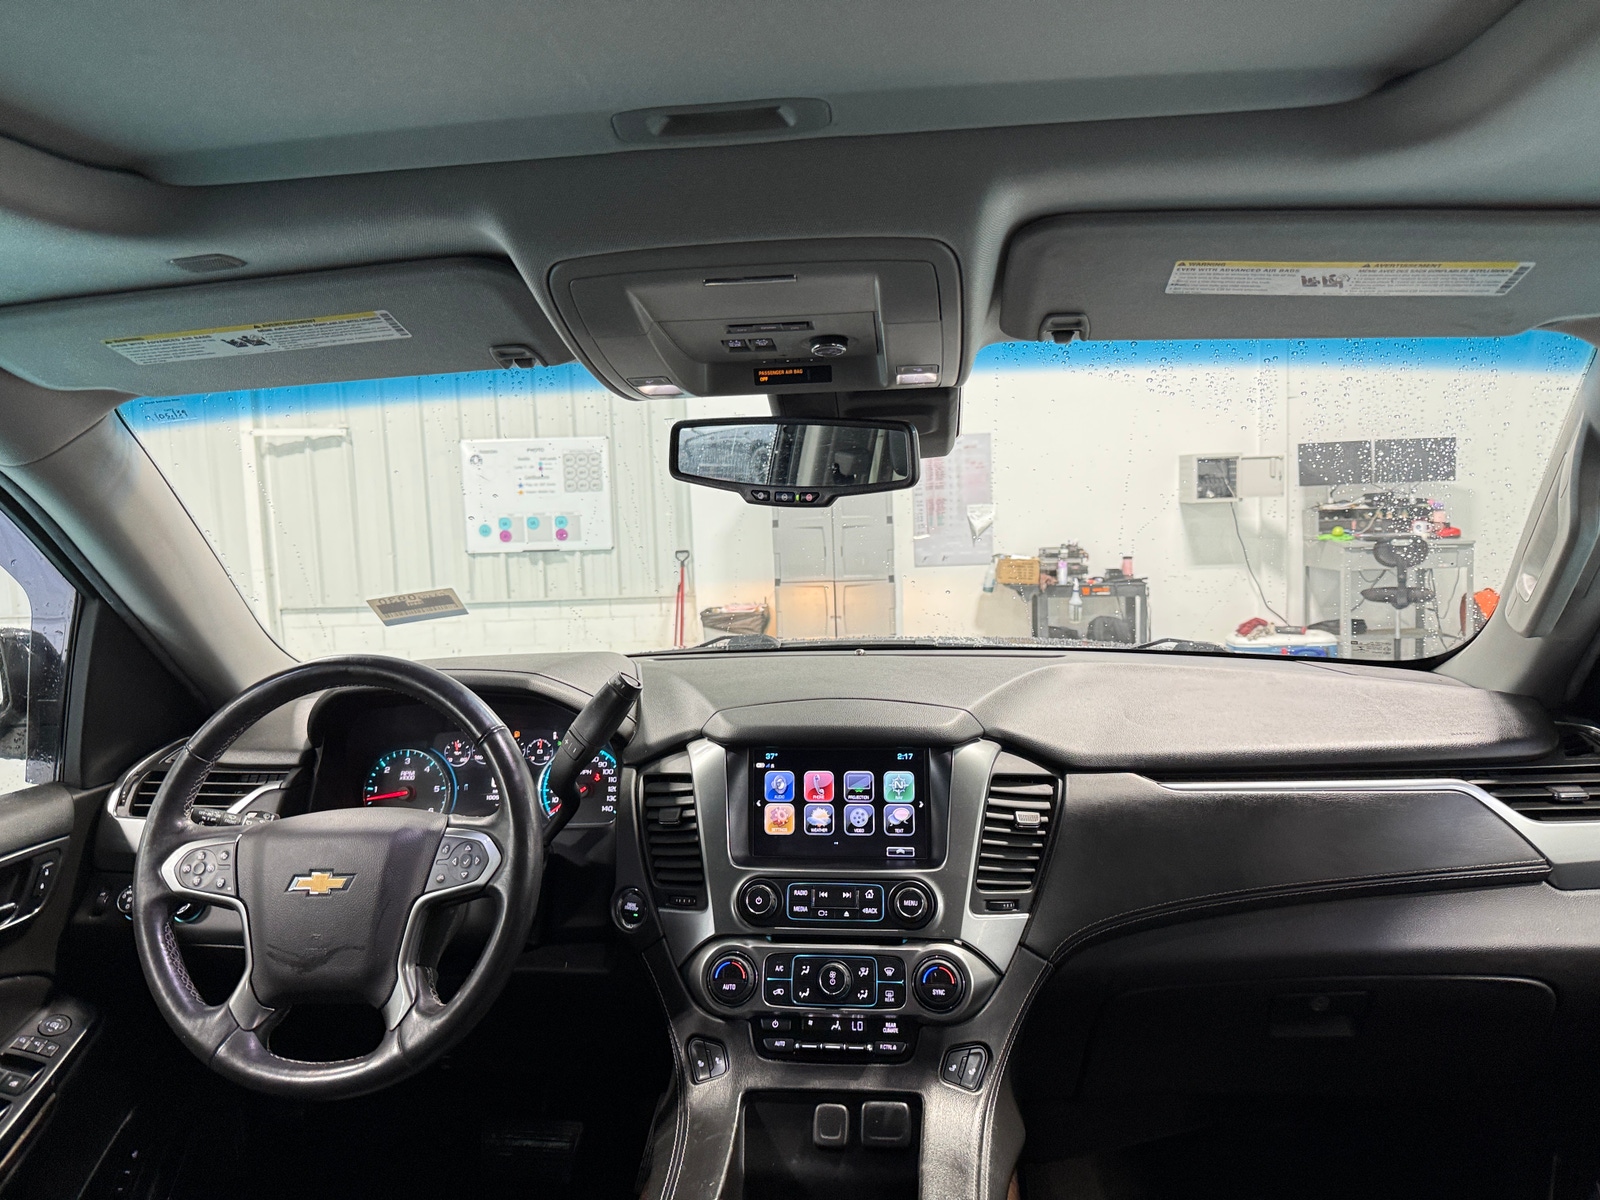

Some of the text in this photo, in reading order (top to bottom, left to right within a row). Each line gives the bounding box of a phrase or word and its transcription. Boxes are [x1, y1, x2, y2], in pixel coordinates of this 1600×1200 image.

[404, 757, 411, 765] 3
[384, 766, 391, 774] 2
[374, 785, 378, 793] 1
[903, 899, 919, 907] MENU
[722, 983, 736, 991] AUTO
[932, 988, 946, 996] SYNC
[851, 1021, 864, 1031] LO
